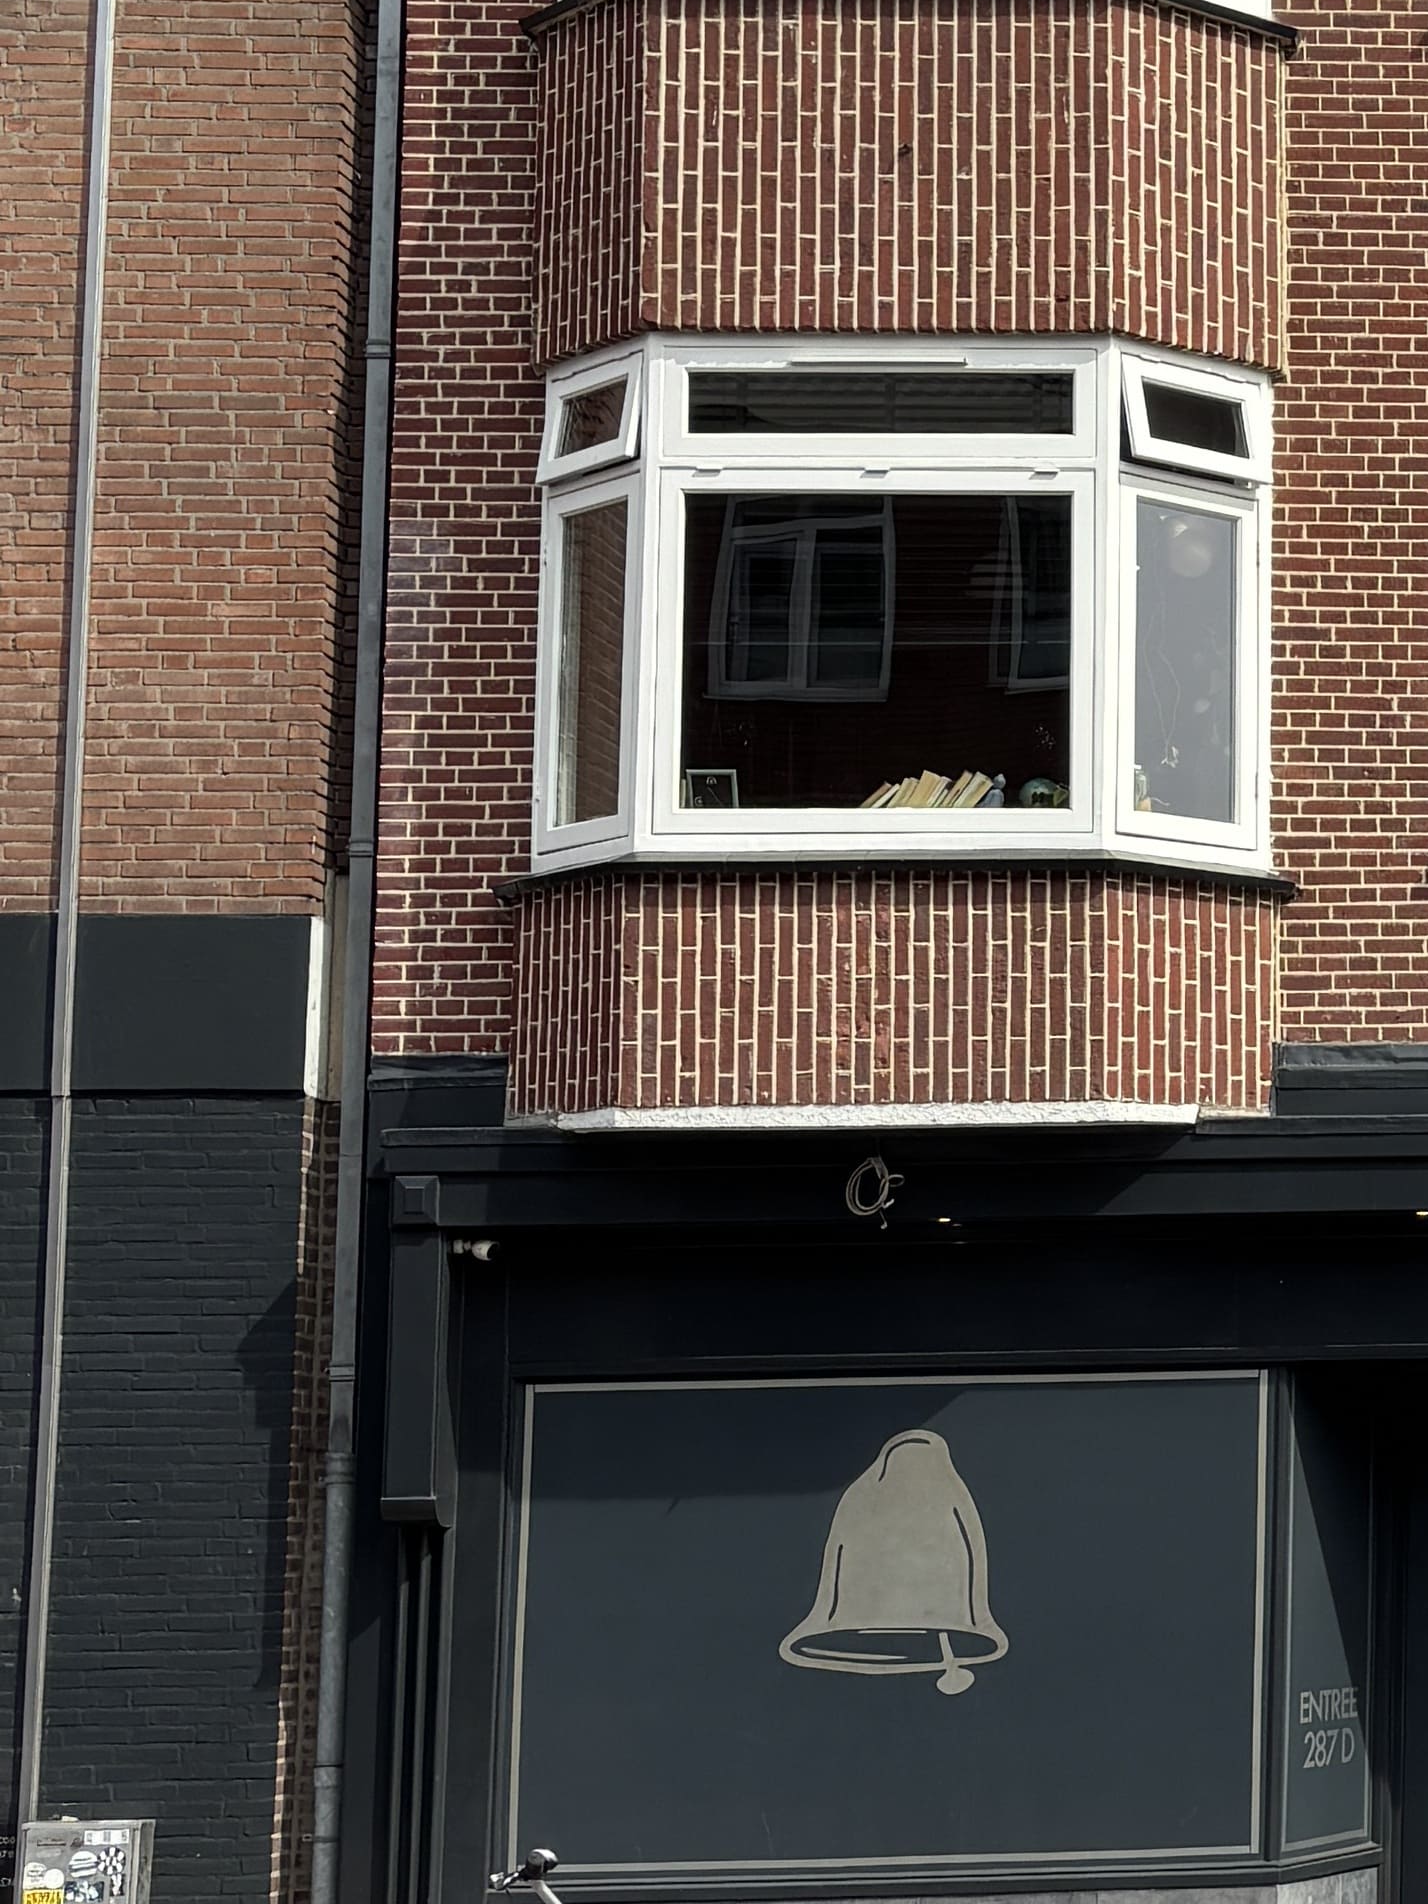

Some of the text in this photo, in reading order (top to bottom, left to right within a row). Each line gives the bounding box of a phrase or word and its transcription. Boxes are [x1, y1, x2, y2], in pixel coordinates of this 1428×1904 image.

[1300, 1687, 1358, 1724] ENTREE
[1303, 1727, 1355, 1768] 287 D
